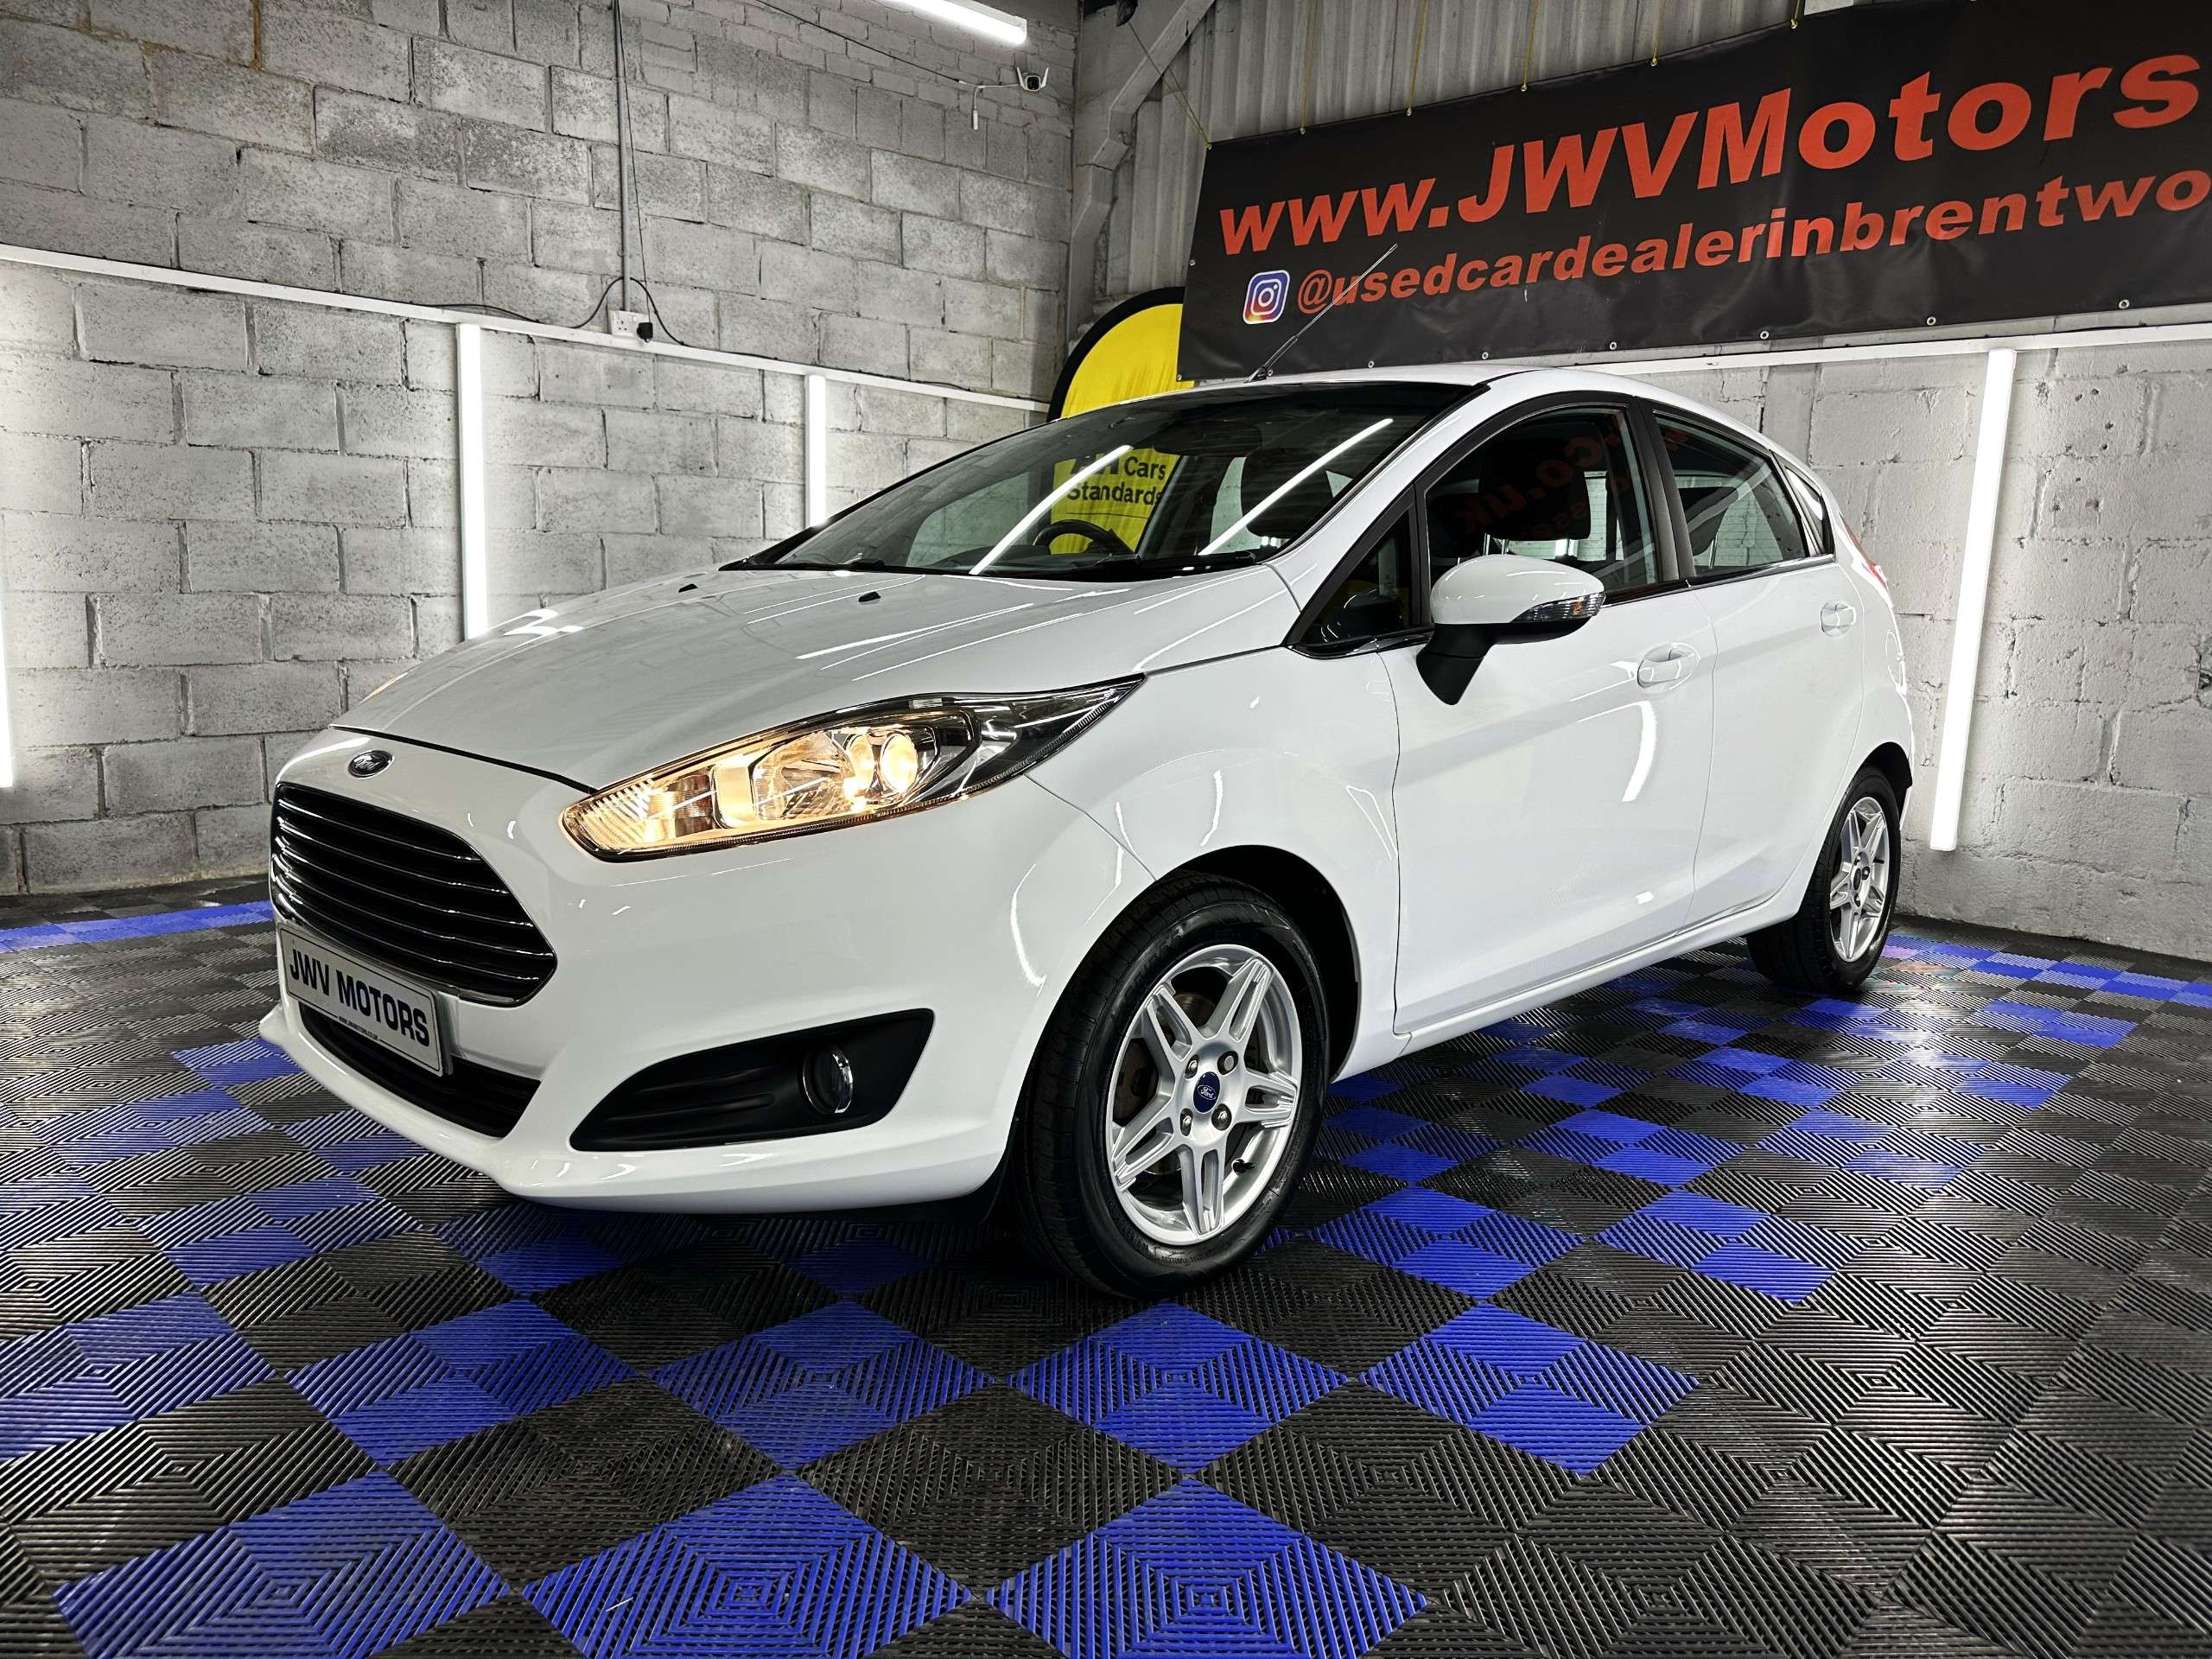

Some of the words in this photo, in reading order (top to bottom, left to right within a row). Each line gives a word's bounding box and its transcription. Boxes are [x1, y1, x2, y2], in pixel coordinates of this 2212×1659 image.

[1219, 54, 2200, 256] www.JWVMotors
[1298, 169, 2212, 315] @usedcardealerinbrentwo
[1123, 455, 1166, 480] Cars
[289, 949, 330, 996] JWV
[335, 969, 430, 1047] MOTORS
[1201, 1086, 1214, 1098] Ford
